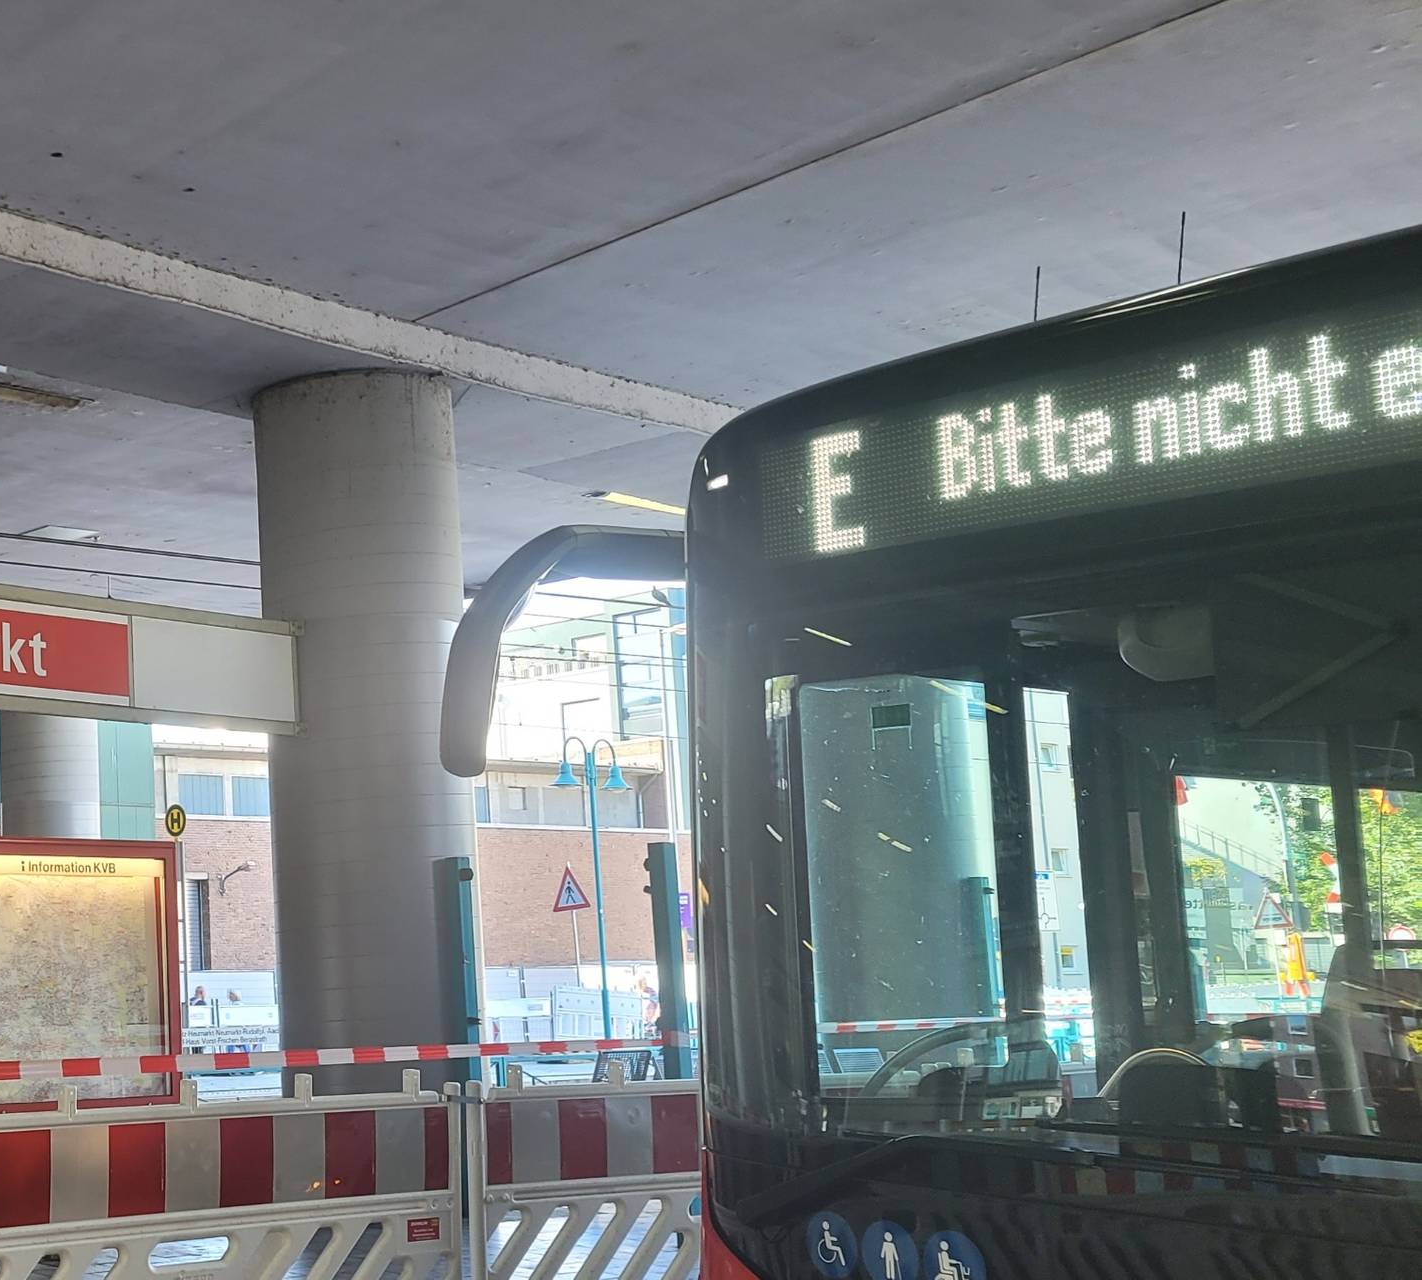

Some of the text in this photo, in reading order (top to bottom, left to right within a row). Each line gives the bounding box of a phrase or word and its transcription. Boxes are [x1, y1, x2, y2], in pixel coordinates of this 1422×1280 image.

[934, 391, 1115, 501] Bitte
[1133, 333, 1352, 464] nicht
[810, 429, 867, 553] E
[170, 811, 181, 830] H
[27, 860, 92, 874] Information
[93, 861, 117, 875] KVB
